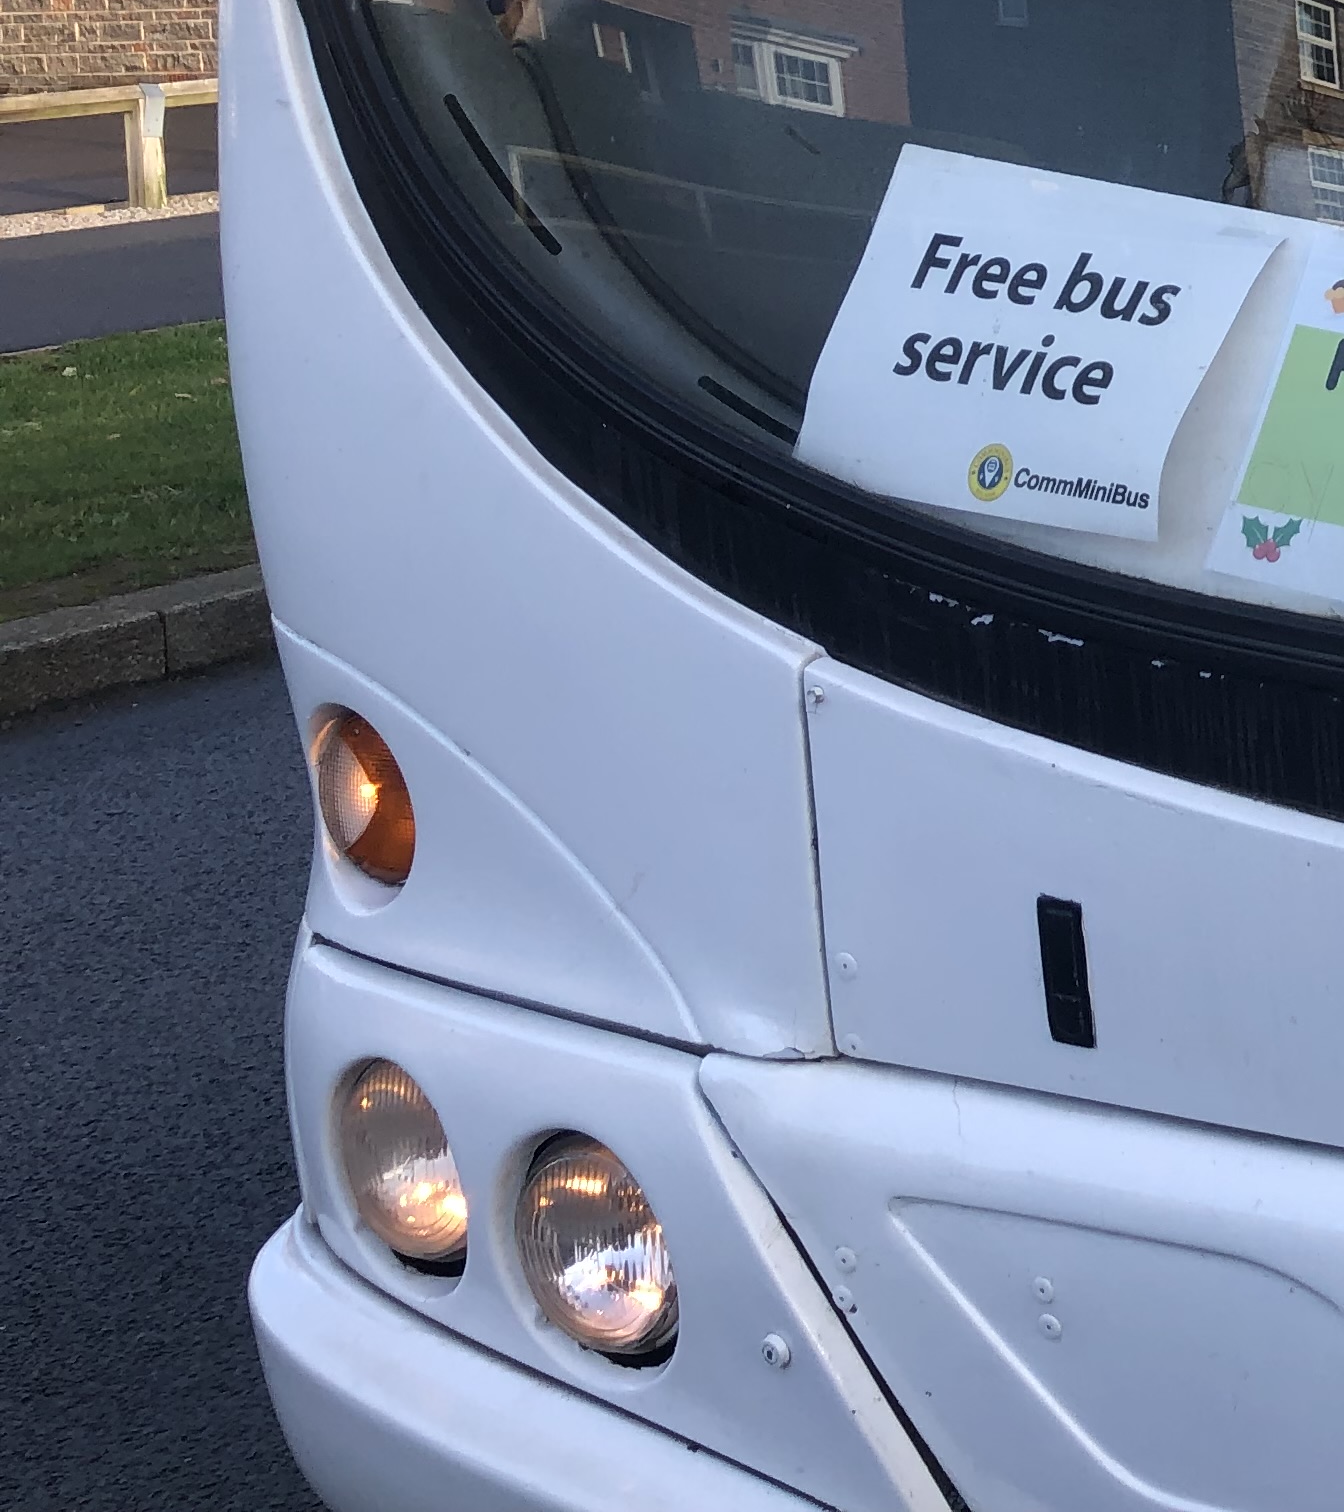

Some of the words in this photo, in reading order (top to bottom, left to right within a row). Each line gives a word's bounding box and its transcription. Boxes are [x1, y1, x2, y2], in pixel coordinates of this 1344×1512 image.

[910, 232, 1048, 306] Free
[1052, 252, 1182, 327] bus
[892, 332, 1114, 406] service
[1013, 467, 1150, 510] CommMiniBus
